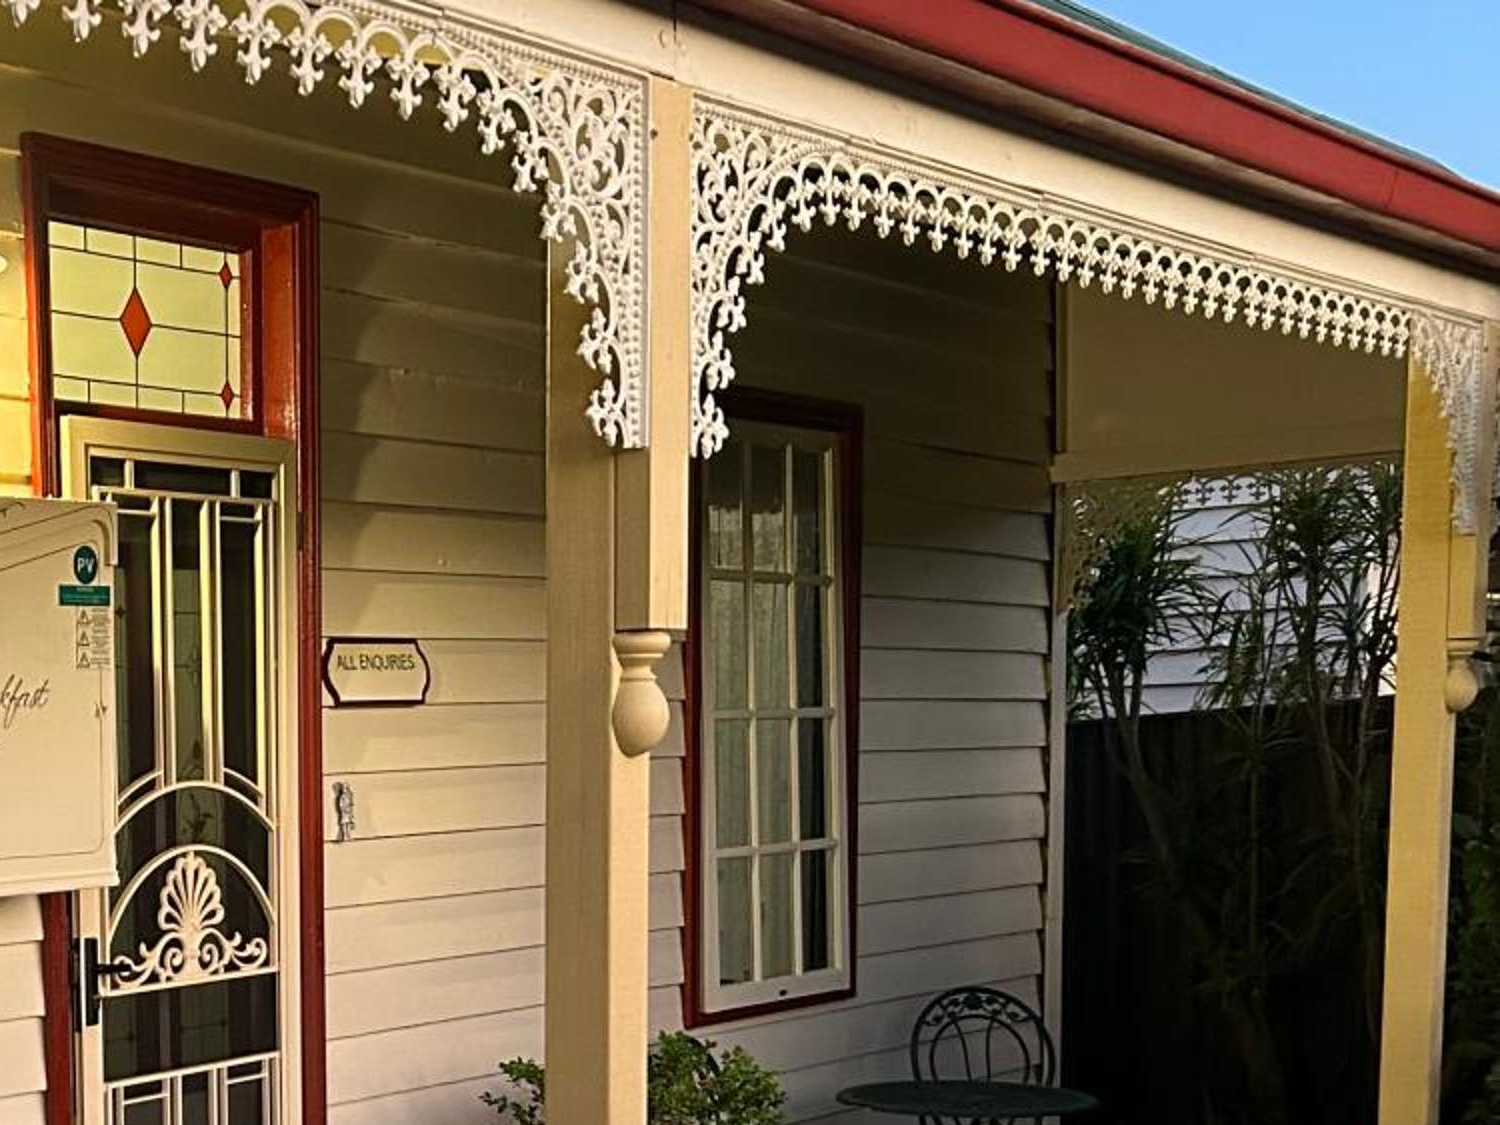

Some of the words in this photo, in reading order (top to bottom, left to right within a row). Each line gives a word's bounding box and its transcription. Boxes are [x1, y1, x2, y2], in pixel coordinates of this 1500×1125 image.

[77, 557, 94, 573] PV
[337, 654, 357, 671] ALL
[360, 653, 415, 672] ENQUIRIES
